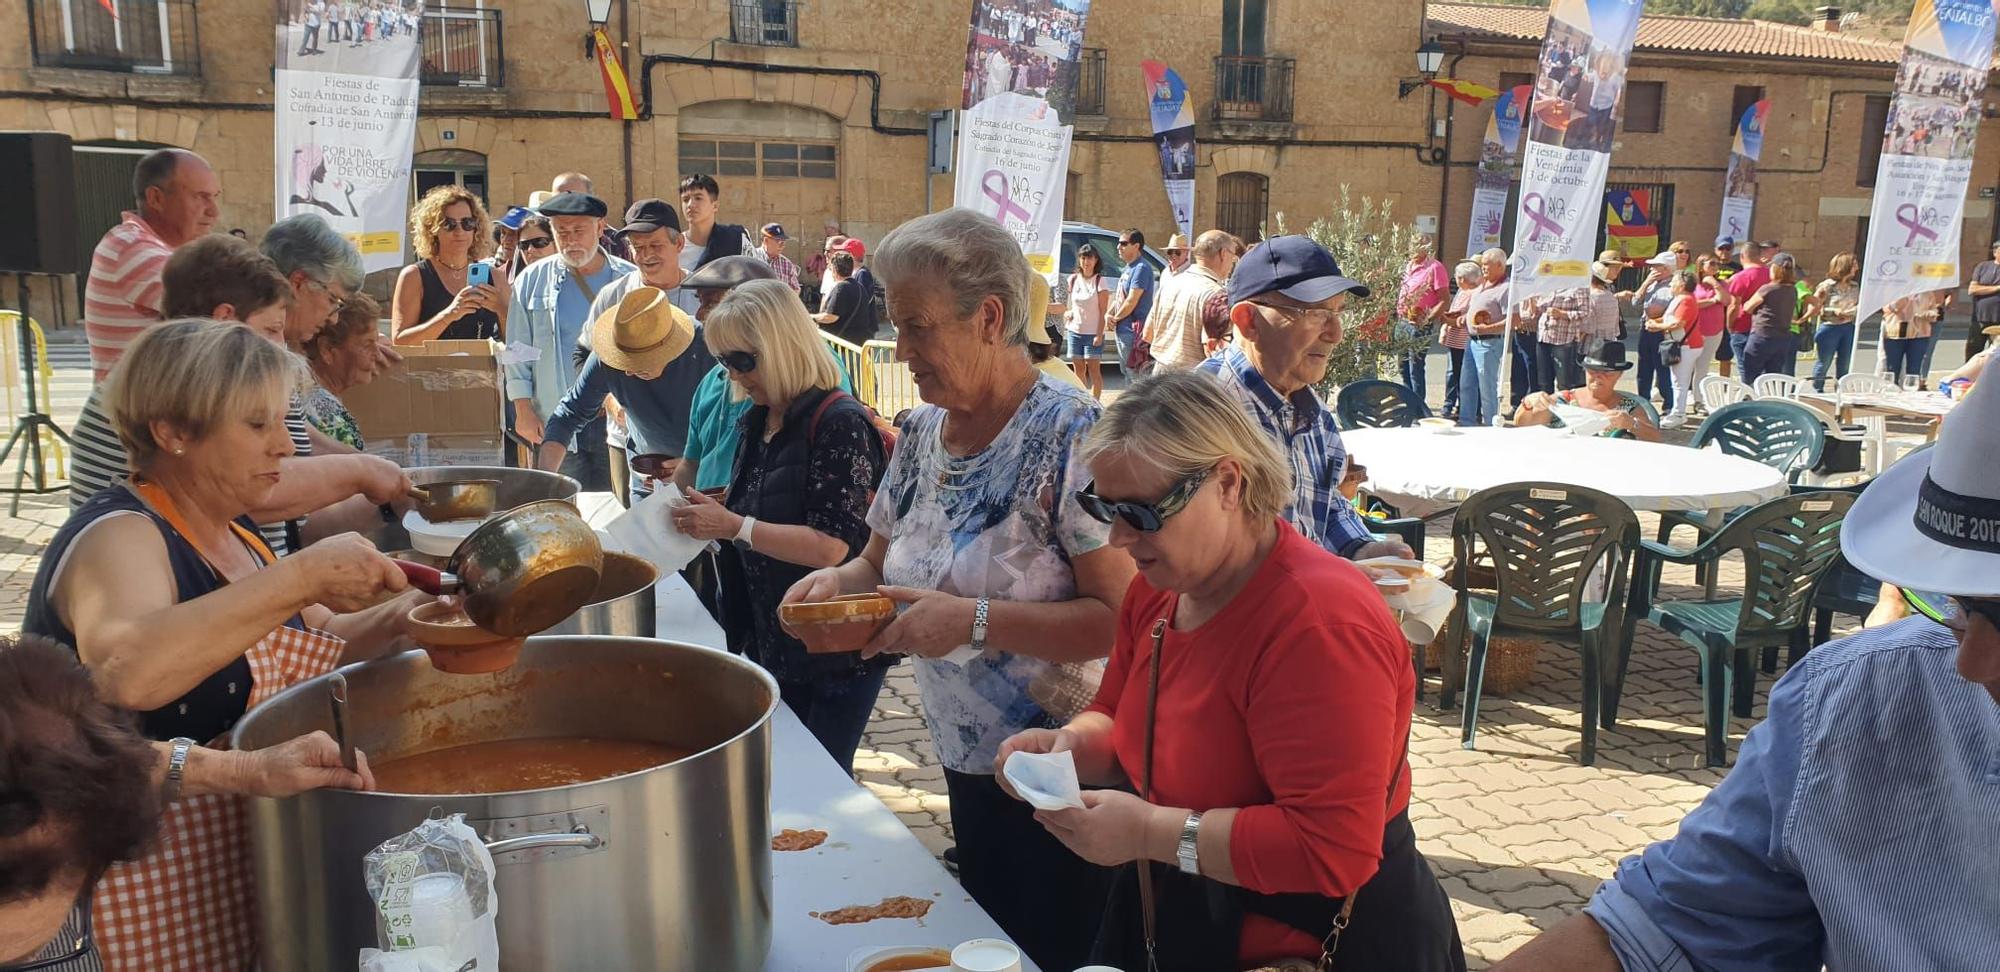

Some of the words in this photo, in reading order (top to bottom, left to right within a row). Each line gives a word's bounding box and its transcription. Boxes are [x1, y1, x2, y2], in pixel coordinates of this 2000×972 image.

[324, 76, 362, 89] Fiestas
[365, 80, 380, 91] de
[290, 87, 311, 99] San
[314, 89, 361, 103] Antonio
[364, 93, 378, 104] de
[382, 95, 416, 107] Padua
[335, 105, 348, 115] de
[351, 106, 370, 117] San
[374, 108, 415, 120] Antonio
[321, 116, 334, 127] 13
[337, 118, 351, 128] de
[352, 120, 384, 132] junio
[974, 117, 1000, 129] Fiestas
[1001, 121, 1013, 131] del
[1014, 123, 1041, 136] Corpus
[970, 129, 1003, 142] Sagrado
[1036, 140, 1046, 149] de
[322, 145, 346, 156] POR
[348, 148, 373, 158] UNA
[1530, 144, 1562, 160] Fiestas
[1565, 151, 1579, 161] de
[1581, 150, 1591, 162] la
[326, 155, 353, 166] VIDA
[356, 157, 386, 169] LIBRE
[995, 157, 1005, 166] 16
[1007, 158, 1018, 168] de
[1020, 161, 1041, 172] junio
[1535, 158, 1583, 173] Vendimia
[338, 166, 353, 176] DE
[1012, 175, 1031, 191] NO
[1537, 171, 1549, 182] de
[1551, 174, 1589, 187] octubre
[1548, 197, 1565, 210] NO
[1921, 207, 1937, 219] NO
[1919, 496, 1930, 524] SAN
[1930, 505, 1965, 538] ROQUE
